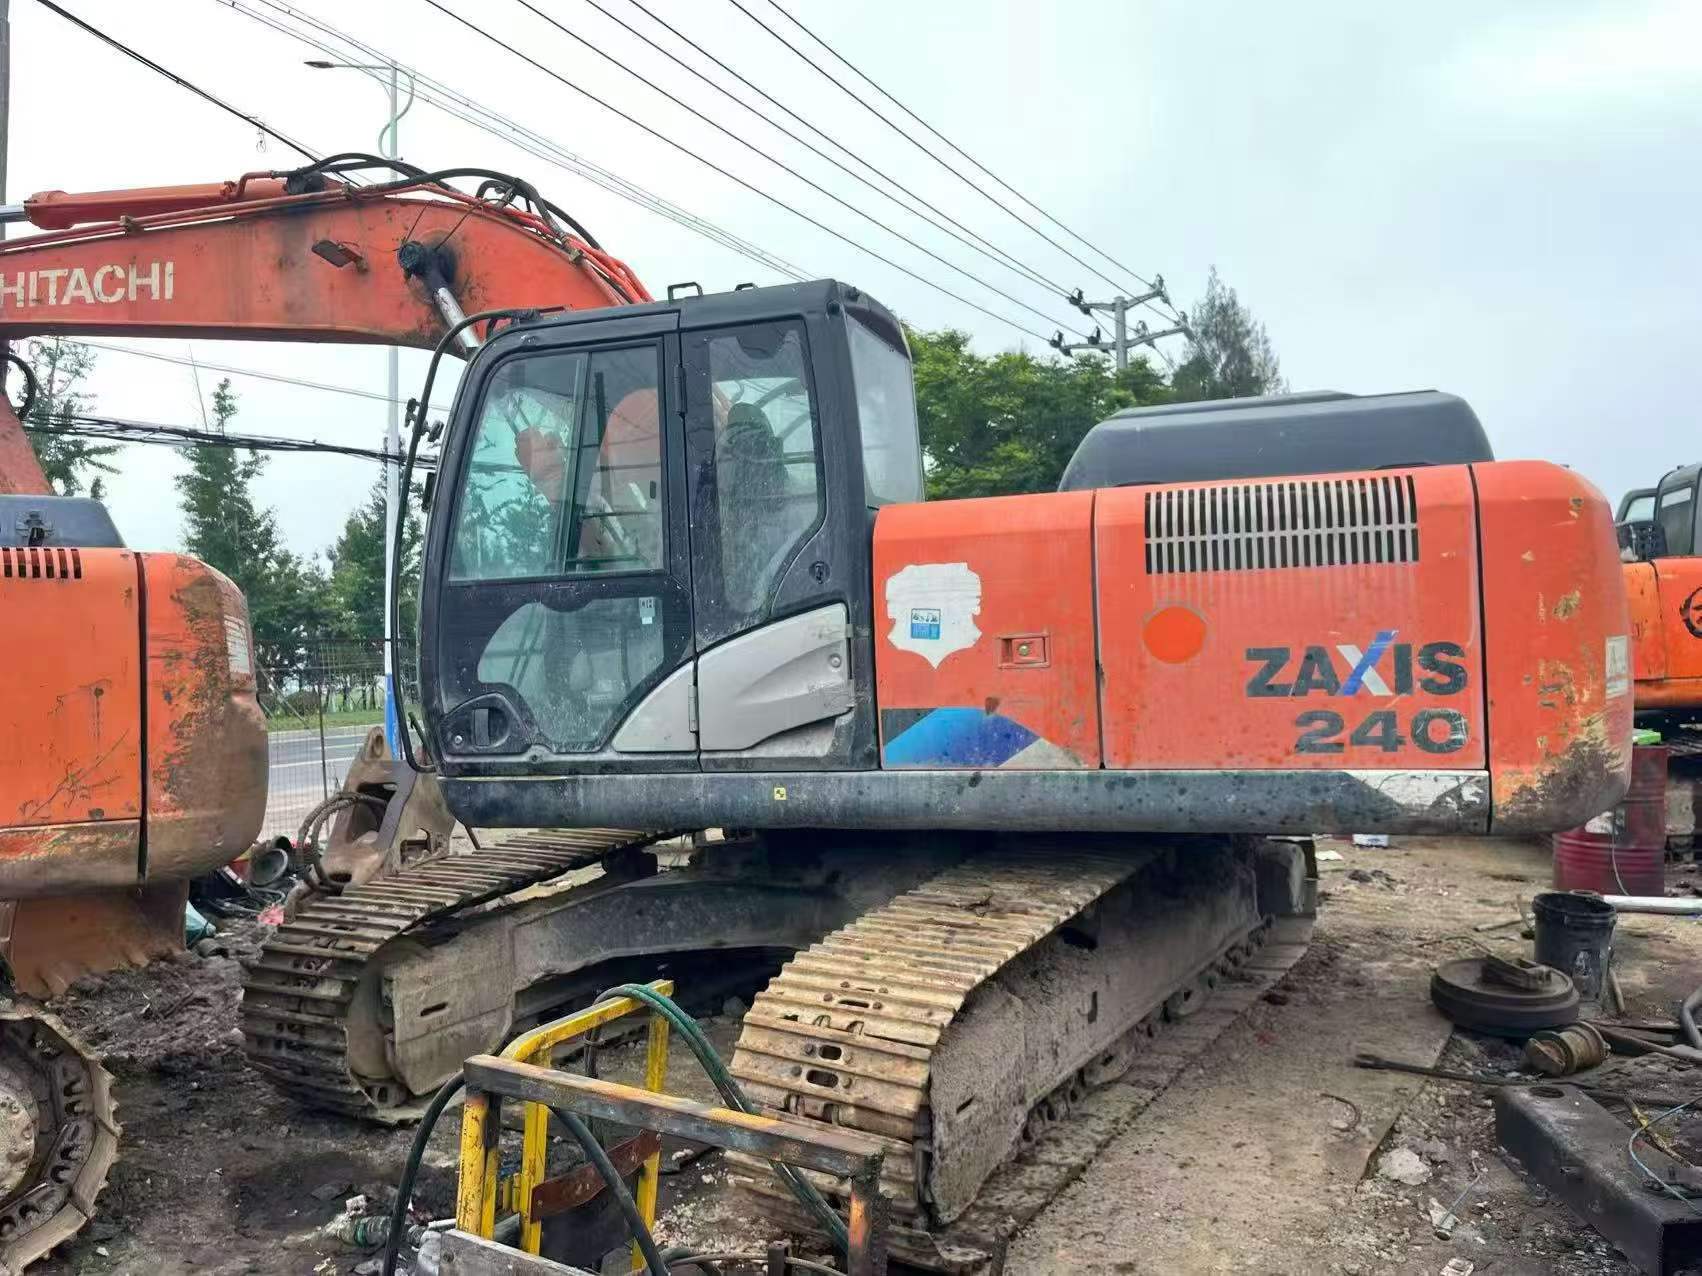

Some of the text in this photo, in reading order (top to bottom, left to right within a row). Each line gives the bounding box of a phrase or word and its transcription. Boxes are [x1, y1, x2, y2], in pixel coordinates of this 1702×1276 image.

[0, 262, 174, 307] HITACHI
[1246, 630, 1468, 697] ZAXIS
[1295, 708, 1469, 754] 240
